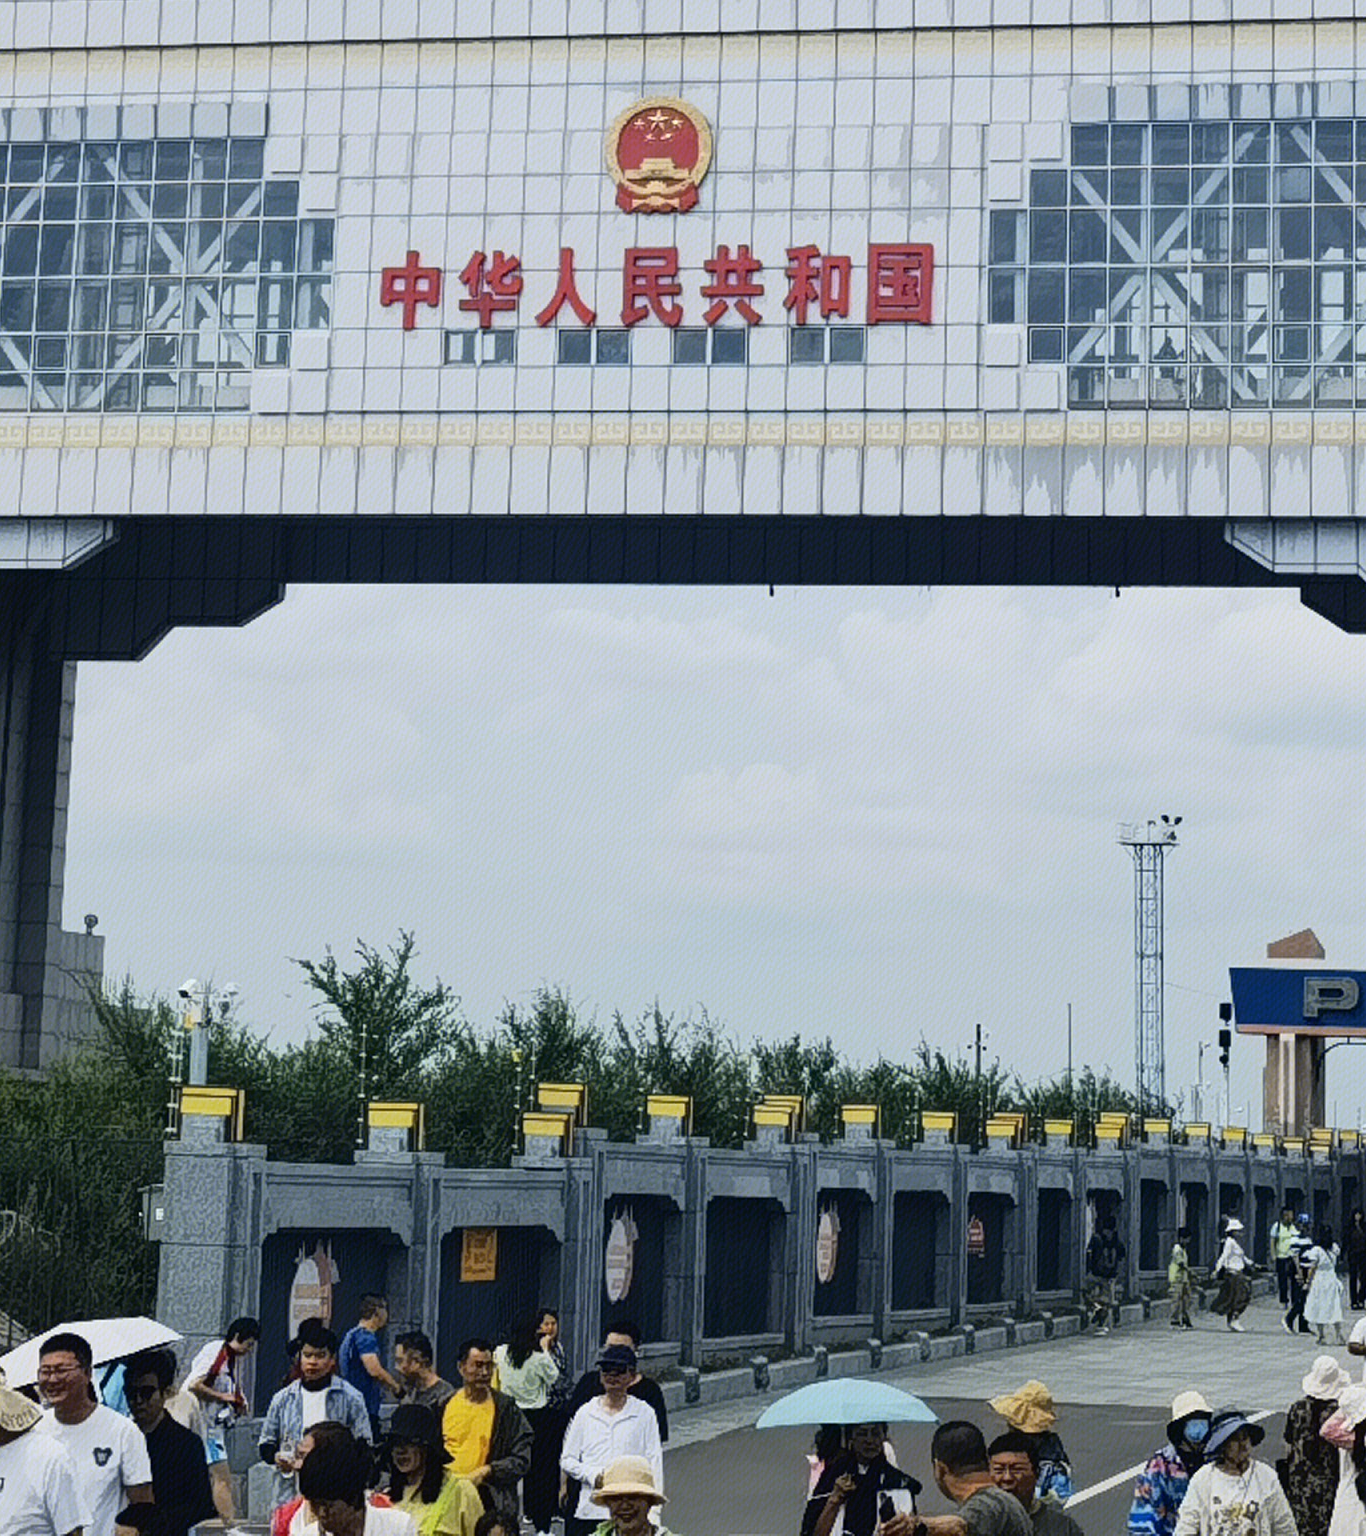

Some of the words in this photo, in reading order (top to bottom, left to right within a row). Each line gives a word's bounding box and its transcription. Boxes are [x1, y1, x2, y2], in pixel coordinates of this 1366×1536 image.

[381, 242, 934, 331] 中华人民共和国
